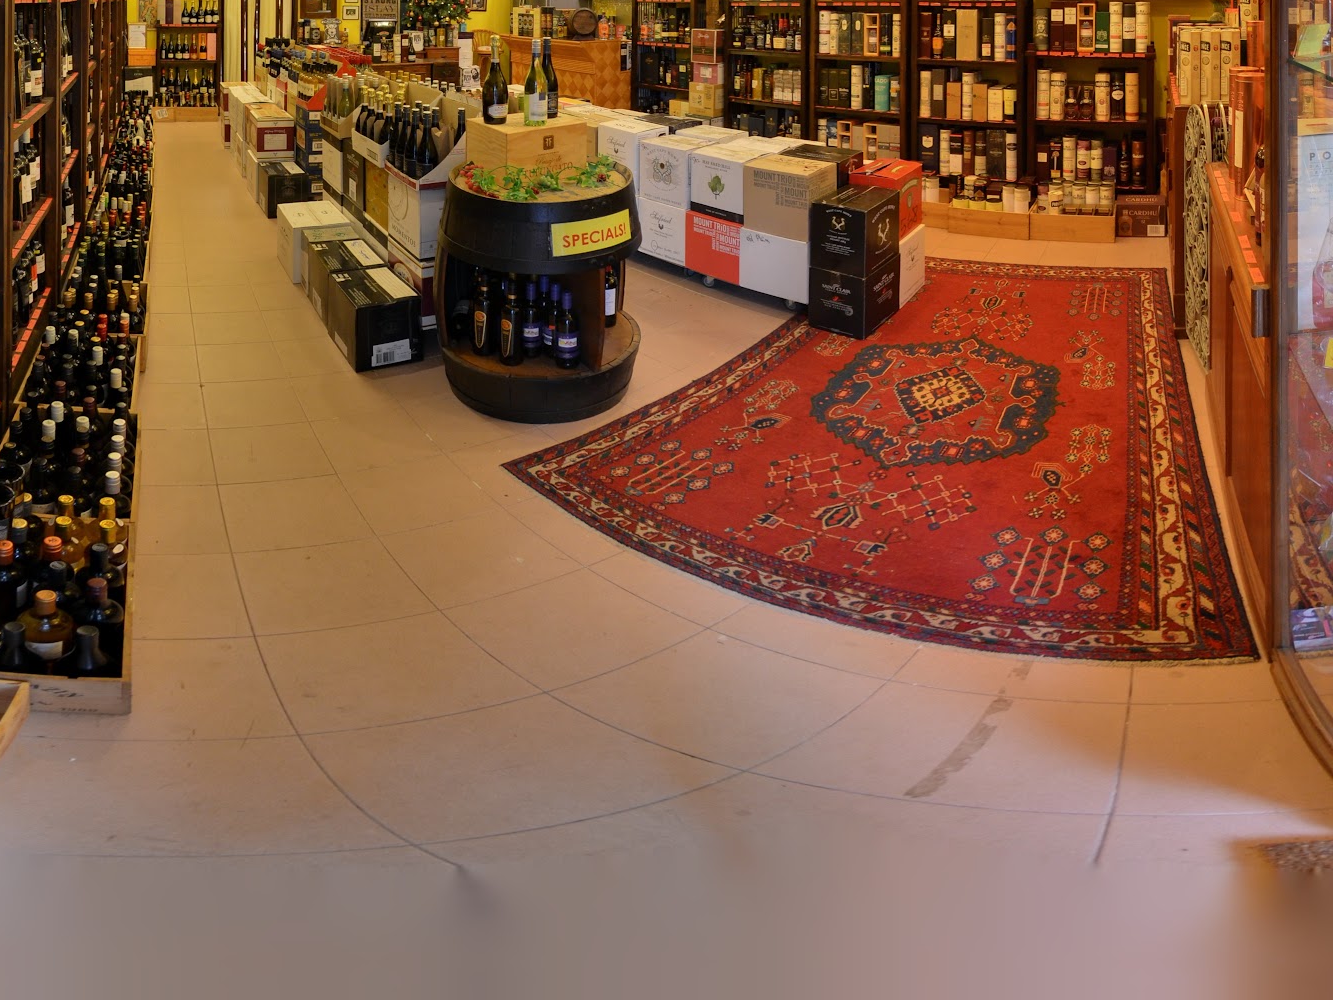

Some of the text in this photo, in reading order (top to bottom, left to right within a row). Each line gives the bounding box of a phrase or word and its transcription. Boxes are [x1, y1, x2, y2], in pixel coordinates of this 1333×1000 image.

[364, 4, 396, 13] ISLAY
[753, 170, 776, 181] MOUNT
[785, 187, 807, 199] MOUNT
[693, 216, 713, 229] MOUNT
[562, 222, 628, 249] SPECIALS!
[719, 234, 740, 246] MOUNT
